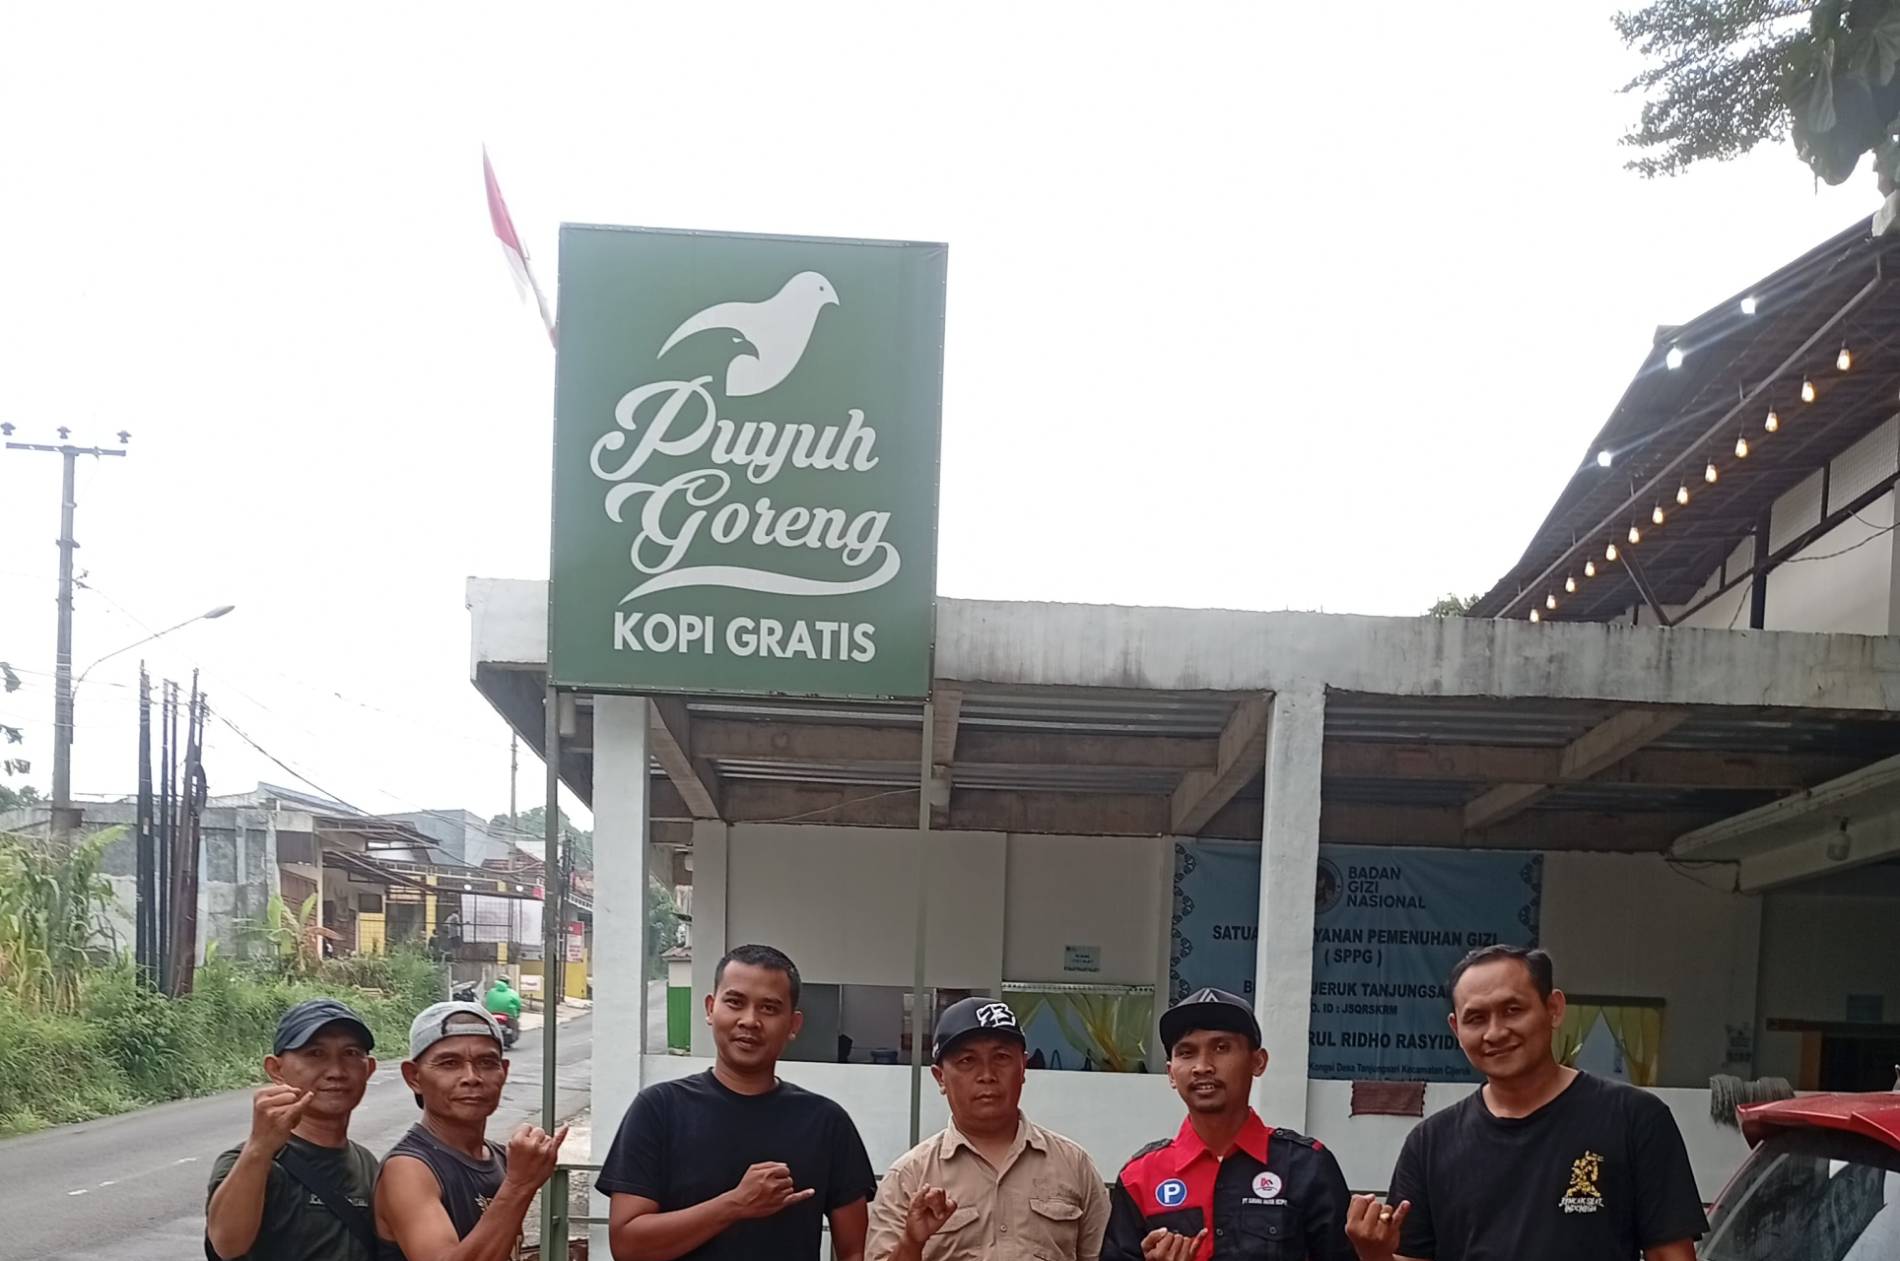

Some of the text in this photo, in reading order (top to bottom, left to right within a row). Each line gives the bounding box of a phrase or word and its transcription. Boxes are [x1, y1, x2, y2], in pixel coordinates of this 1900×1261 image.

[590, 376, 880, 484] Puyuh
[604, 469, 900, 590] Goreng
[613, 611, 877, 662] KOPI GRATIS
[1347, 866, 1401, 881] BADAN
[1347, 880, 1379, 894] GIZI
[1346, 894, 1426, 910] NASIONAL
[1212, 925, 1498, 948] SATUA YANAN PEMENUHAN GIZI
[1311, 981, 1449, 999] JERUK TANJUNGSA
[1309, 1031, 1460, 1050] RUL RIDHO RASYID
[1164, 1183, 1180, 1203] P
